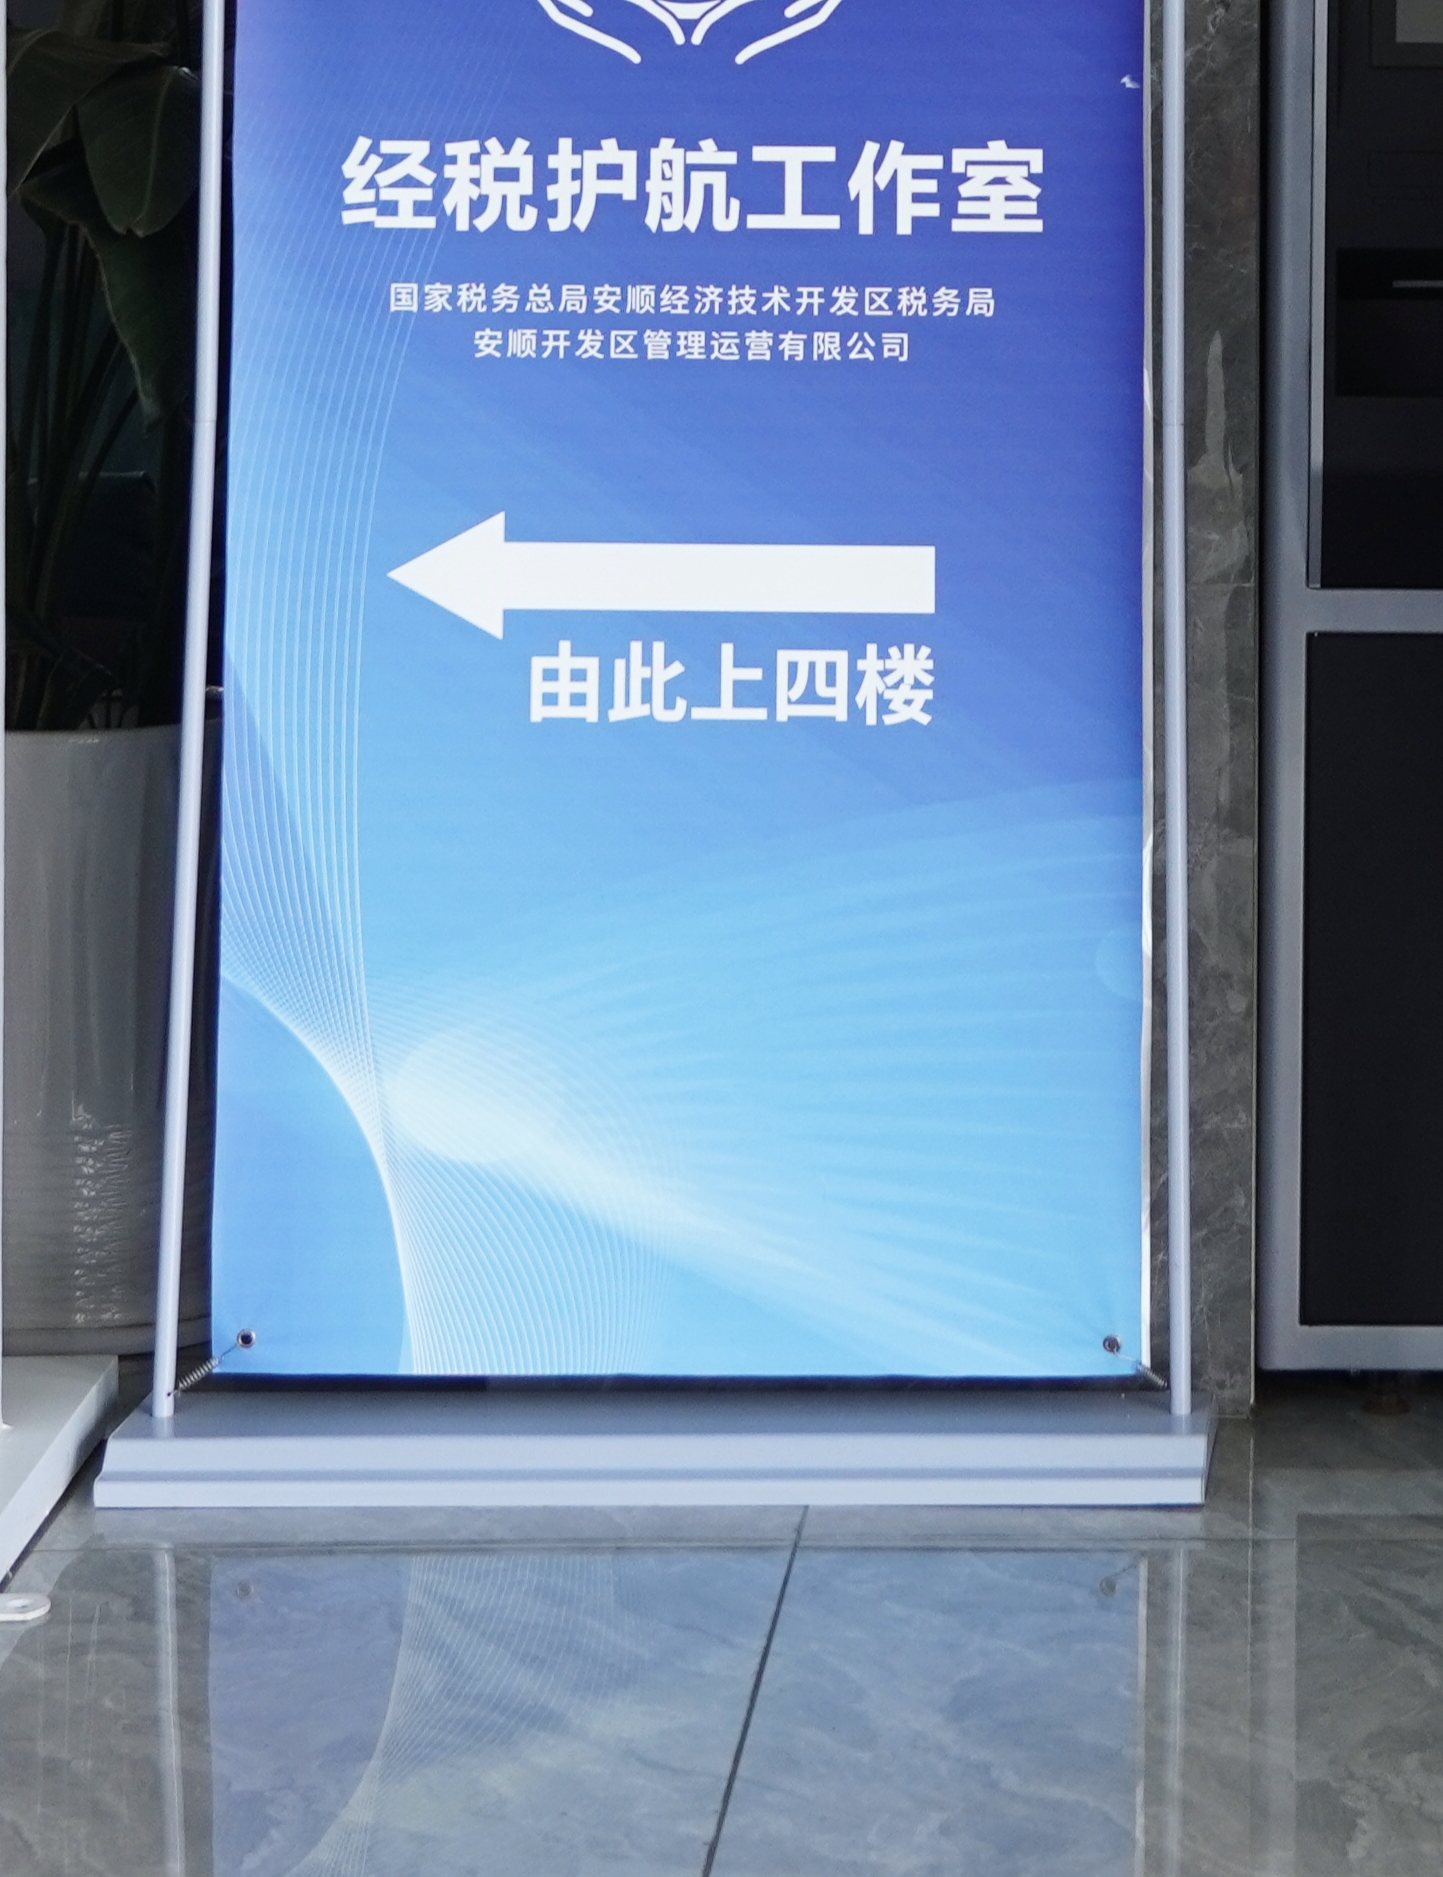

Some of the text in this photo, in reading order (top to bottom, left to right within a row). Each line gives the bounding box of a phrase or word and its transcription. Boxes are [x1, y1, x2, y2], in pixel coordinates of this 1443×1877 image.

[341, 136, 1045, 236] 经税护航工作室
[388, 282, 996, 319] 国家税务总局安顺经济技术开发区税务局
[473, 329, 911, 363] 安顺开发区管理运营有限公司
[529, 640, 935, 726] 由此上四楼
